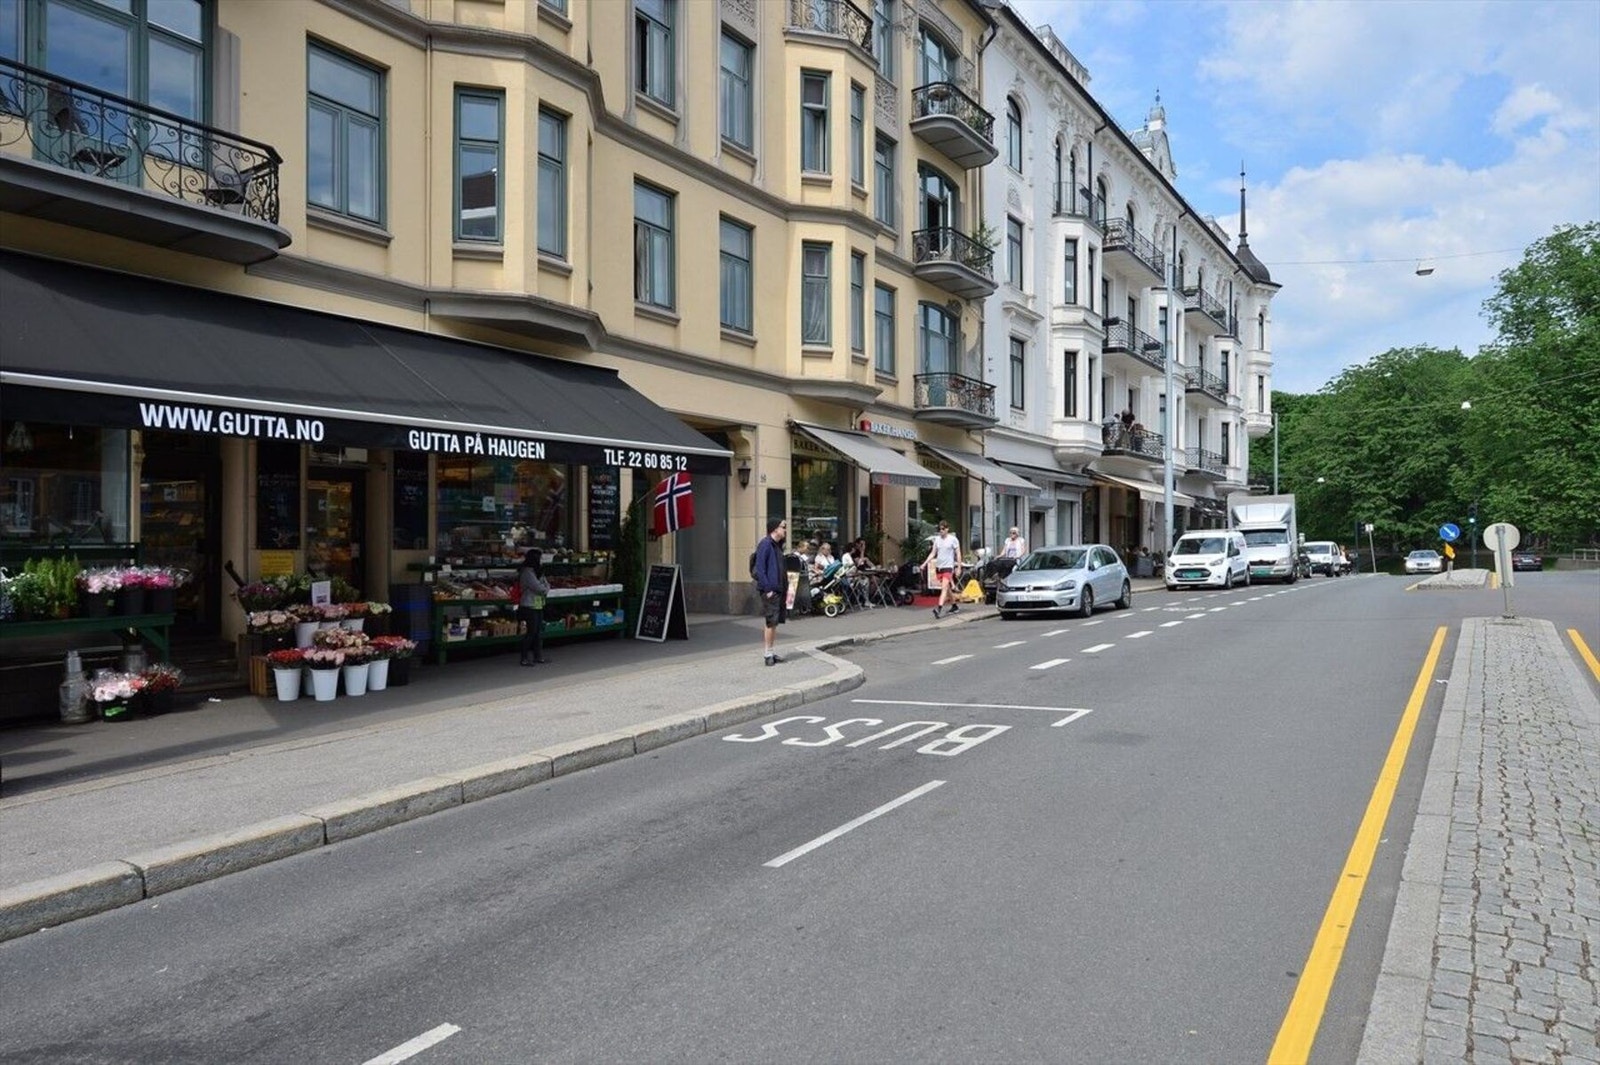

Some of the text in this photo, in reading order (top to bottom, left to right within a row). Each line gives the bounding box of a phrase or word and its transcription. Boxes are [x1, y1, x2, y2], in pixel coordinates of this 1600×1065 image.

[139, 403, 325, 442] WWW.GUTTA.NO
[408, 430, 546, 460] GUTTA PÅ HAUGEN
[603, 448, 688, 471] TLF. 22 60 85 12
[722, 716, 1012, 756] BUSS
